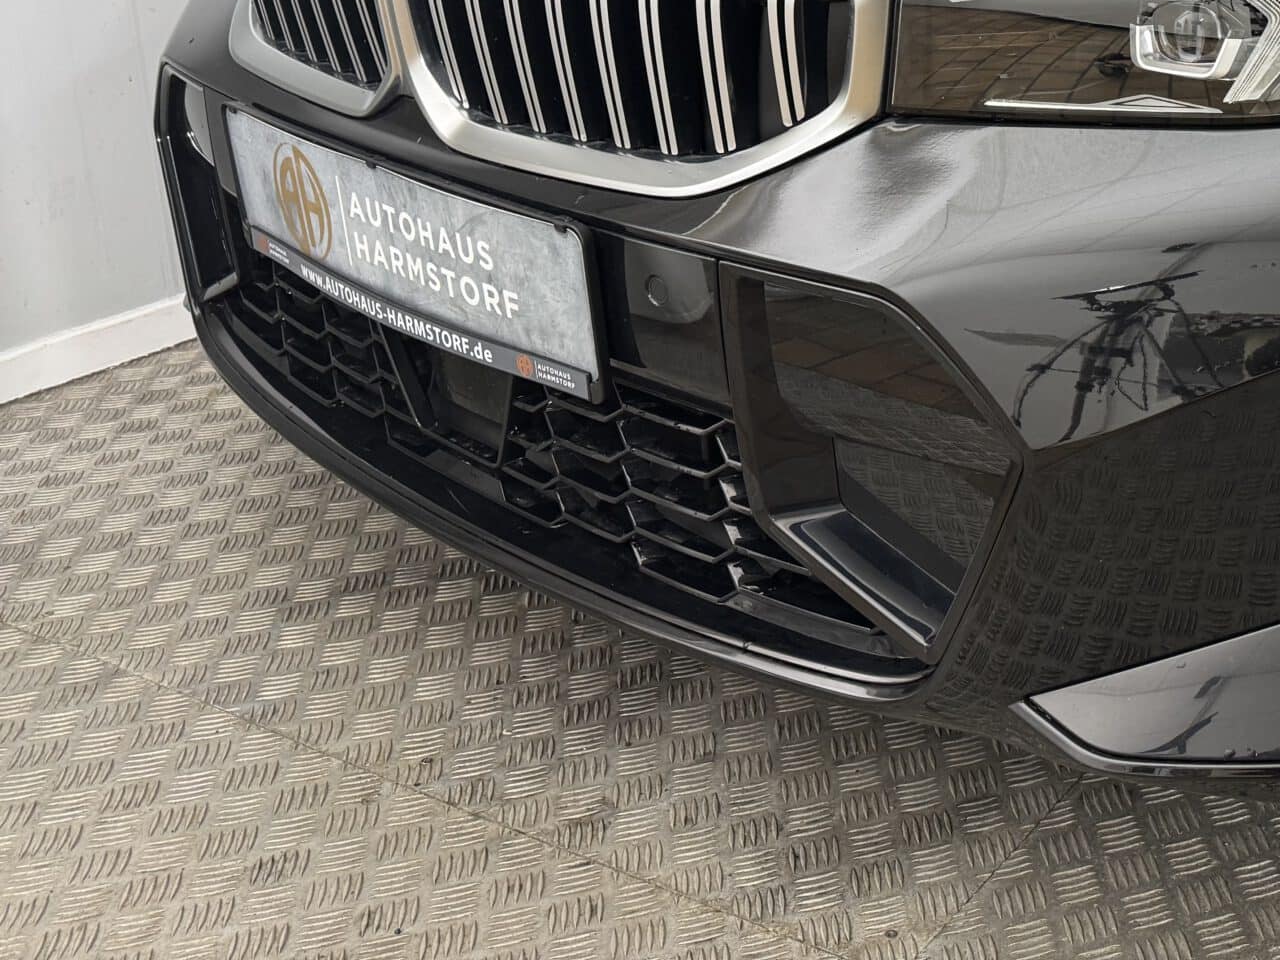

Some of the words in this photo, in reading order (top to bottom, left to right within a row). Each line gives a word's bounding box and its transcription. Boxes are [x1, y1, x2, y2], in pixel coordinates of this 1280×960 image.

[350, 192, 494, 271] AUTOHAUS
[301, 263, 493, 363] www.AUTOHAUS-HARMSTORF.de
[353, 232, 520, 319] HARMSTORF
[538, 364, 571, 380] AUTOHAUS
[538, 372, 575, 389] HARMSTORF
